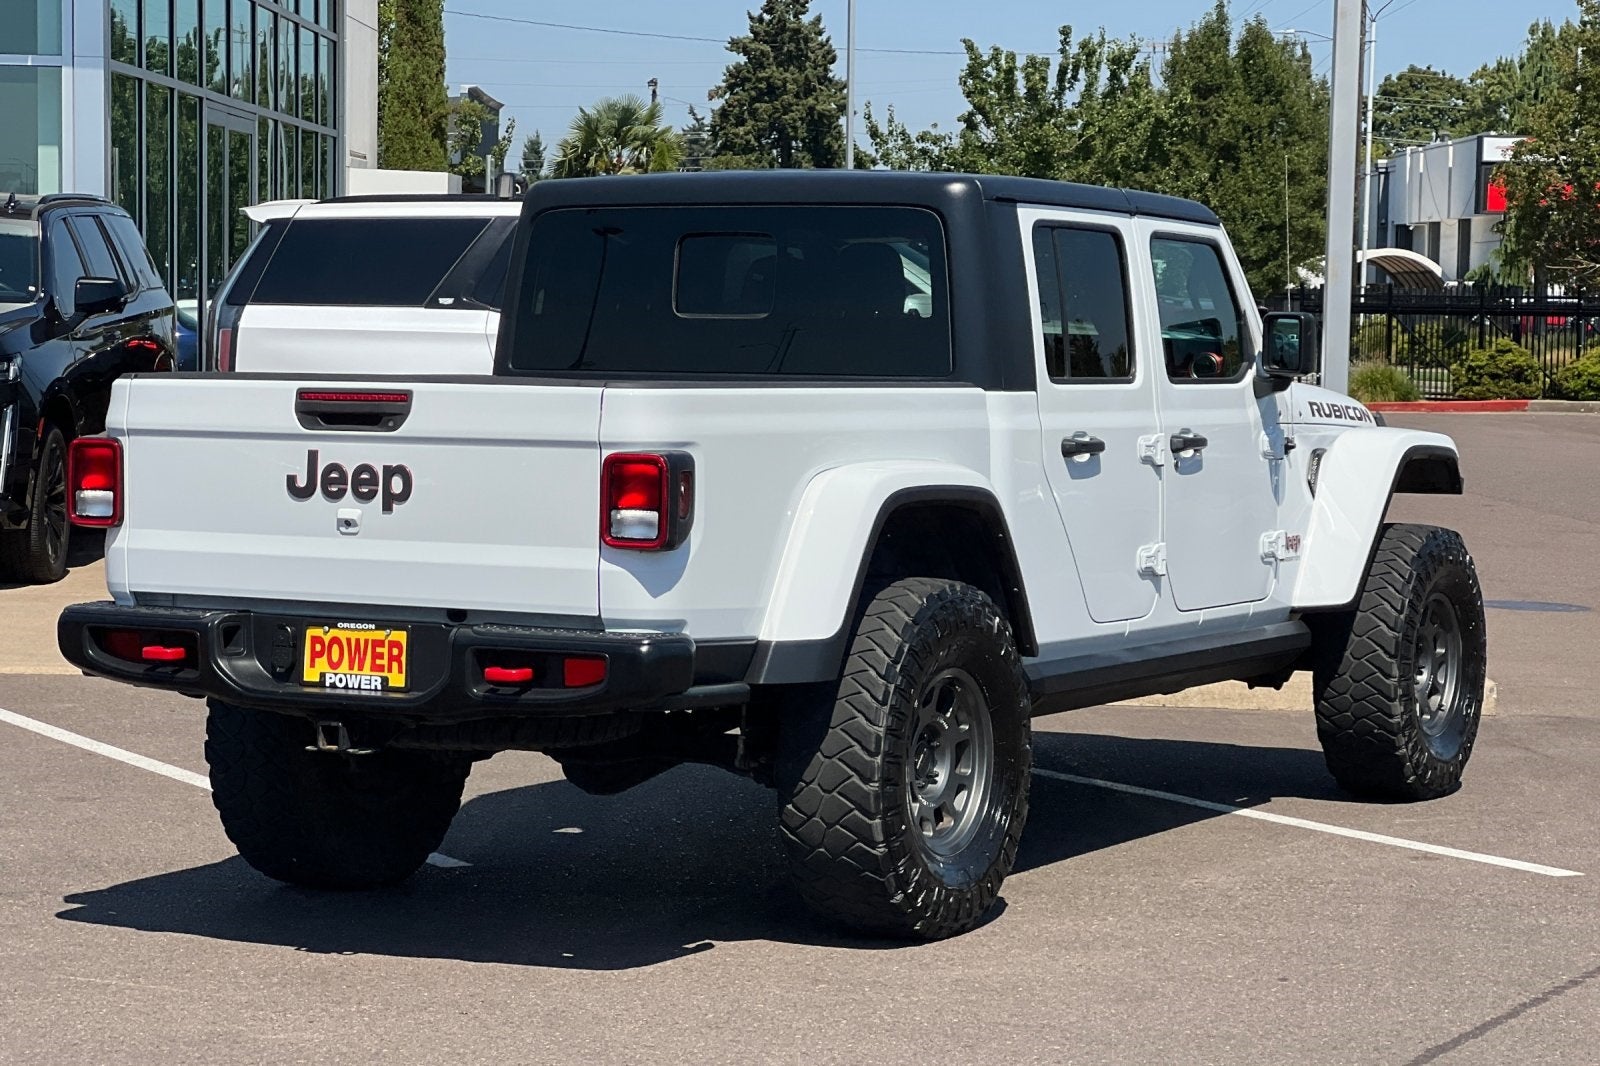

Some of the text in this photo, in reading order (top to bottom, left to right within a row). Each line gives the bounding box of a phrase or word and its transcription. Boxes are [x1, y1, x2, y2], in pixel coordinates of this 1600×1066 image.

[1308, 401, 1372, 423] RUBICON
[286, 449, 413, 512] Jeep
[337, 622, 375, 630] OREGON
[309, 635, 404, 674] POWER
[325, 673, 382, 690] POWER
